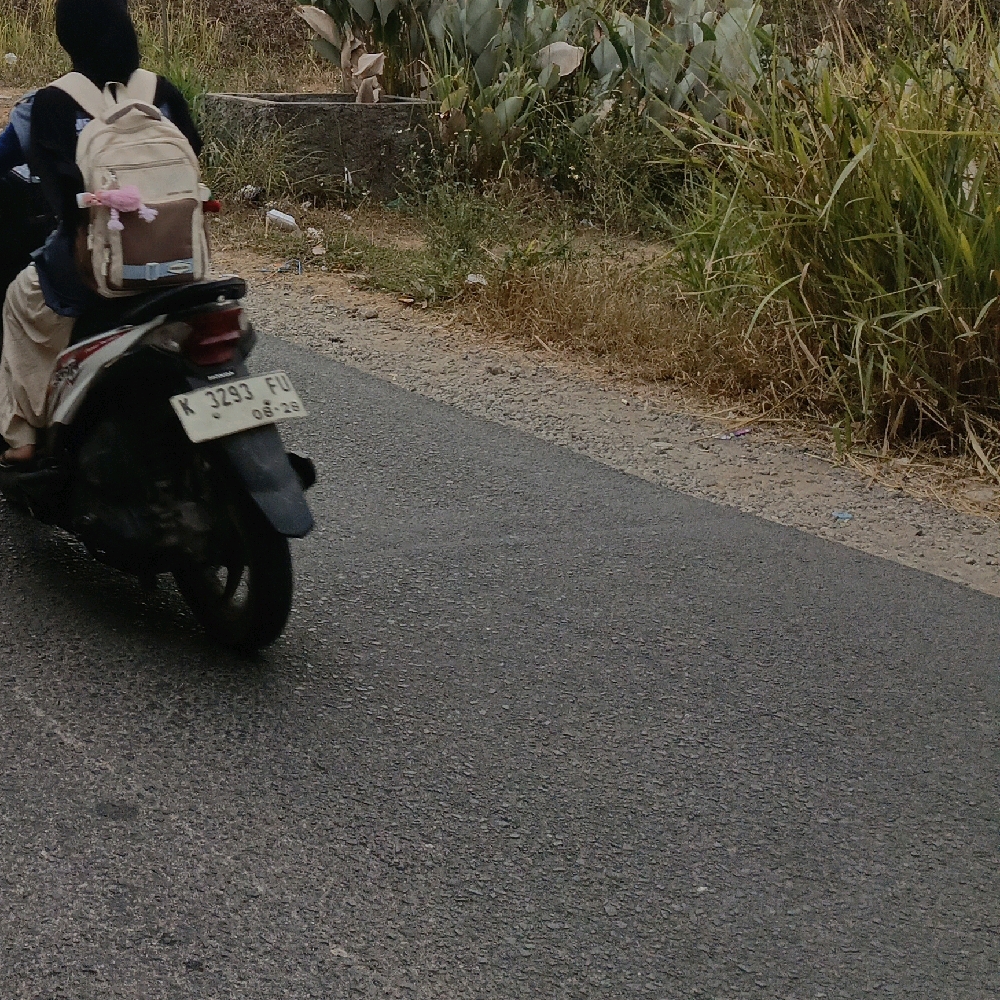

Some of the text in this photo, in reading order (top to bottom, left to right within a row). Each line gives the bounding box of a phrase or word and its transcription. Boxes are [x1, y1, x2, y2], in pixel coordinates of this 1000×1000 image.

[178, 375, 290, 416] K 3293 FU
